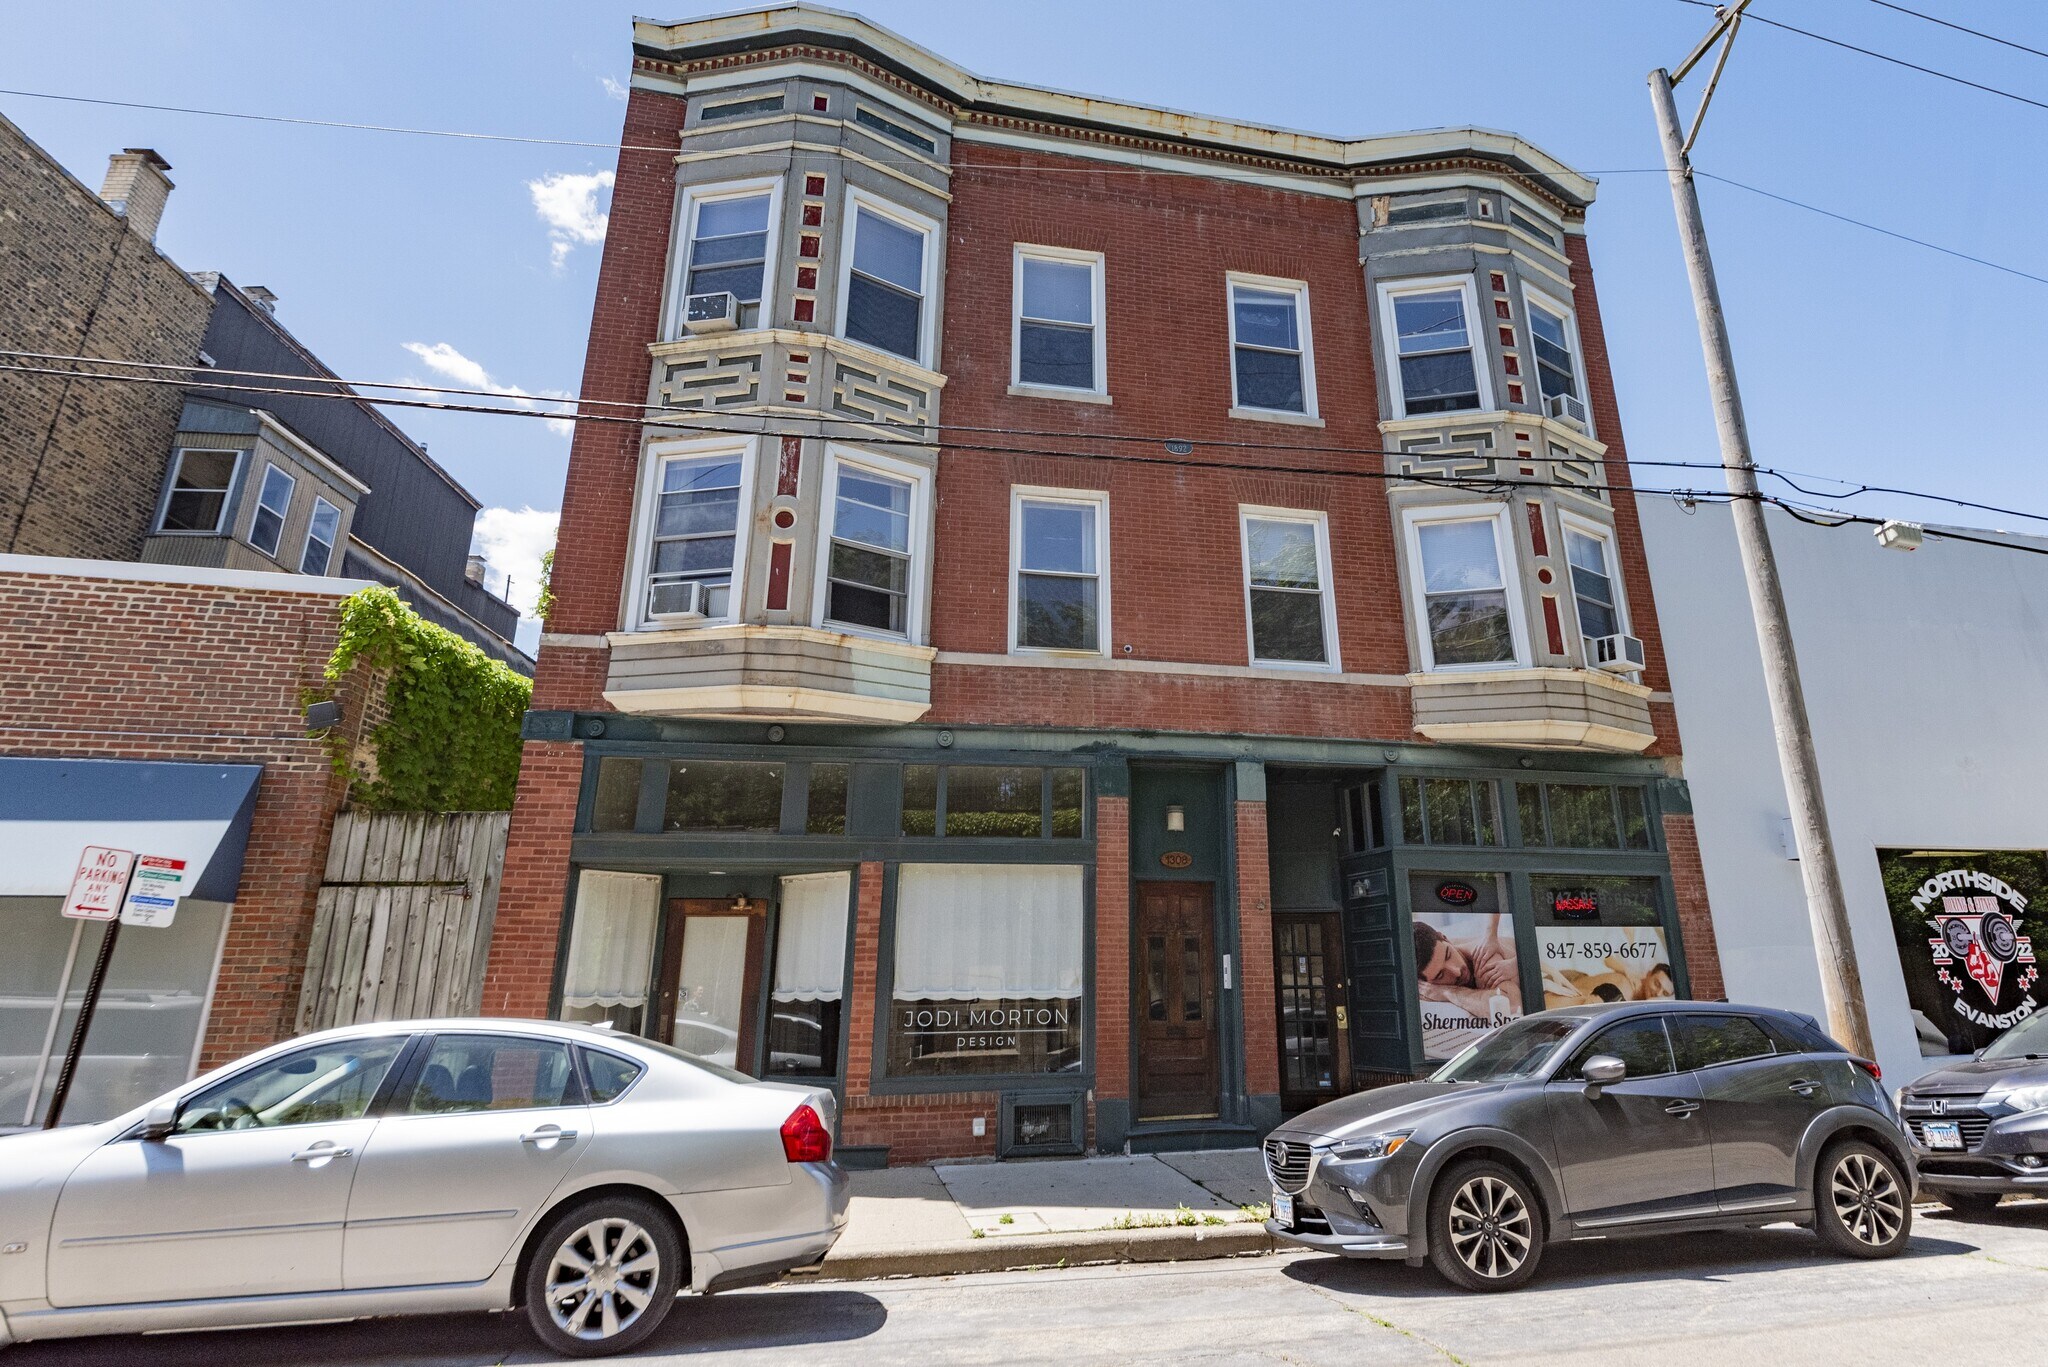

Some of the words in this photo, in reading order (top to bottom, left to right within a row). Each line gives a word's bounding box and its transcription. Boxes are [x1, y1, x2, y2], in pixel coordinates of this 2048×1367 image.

[96, 853, 117, 868] NO
[1165, 855, 1188, 865] 1308
[79, 867, 125, 885] PARKING
[87, 883, 109, 893] ANY
[1440, 887, 1473, 900] OPEN
[1910, 869, 2029, 914] NORTHSIDE
[83, 893, 108, 904] TIME
[1555, 897, 1596, 911] MASSAGE
[1546, 942, 1658, 959] 847-859-6677
[1931, 944, 1950, 958] 20
[2017, 943, 2033, 957] 22
[904, 1010, 958, 1028] JODI
[969, 1008, 1069, 1026] MORTON
[1953, 994, 2038, 1029] EVANSTON
[1422, 1011, 1492, 1030] Sherman
[957, 1036, 1016, 1047] DESIGN
